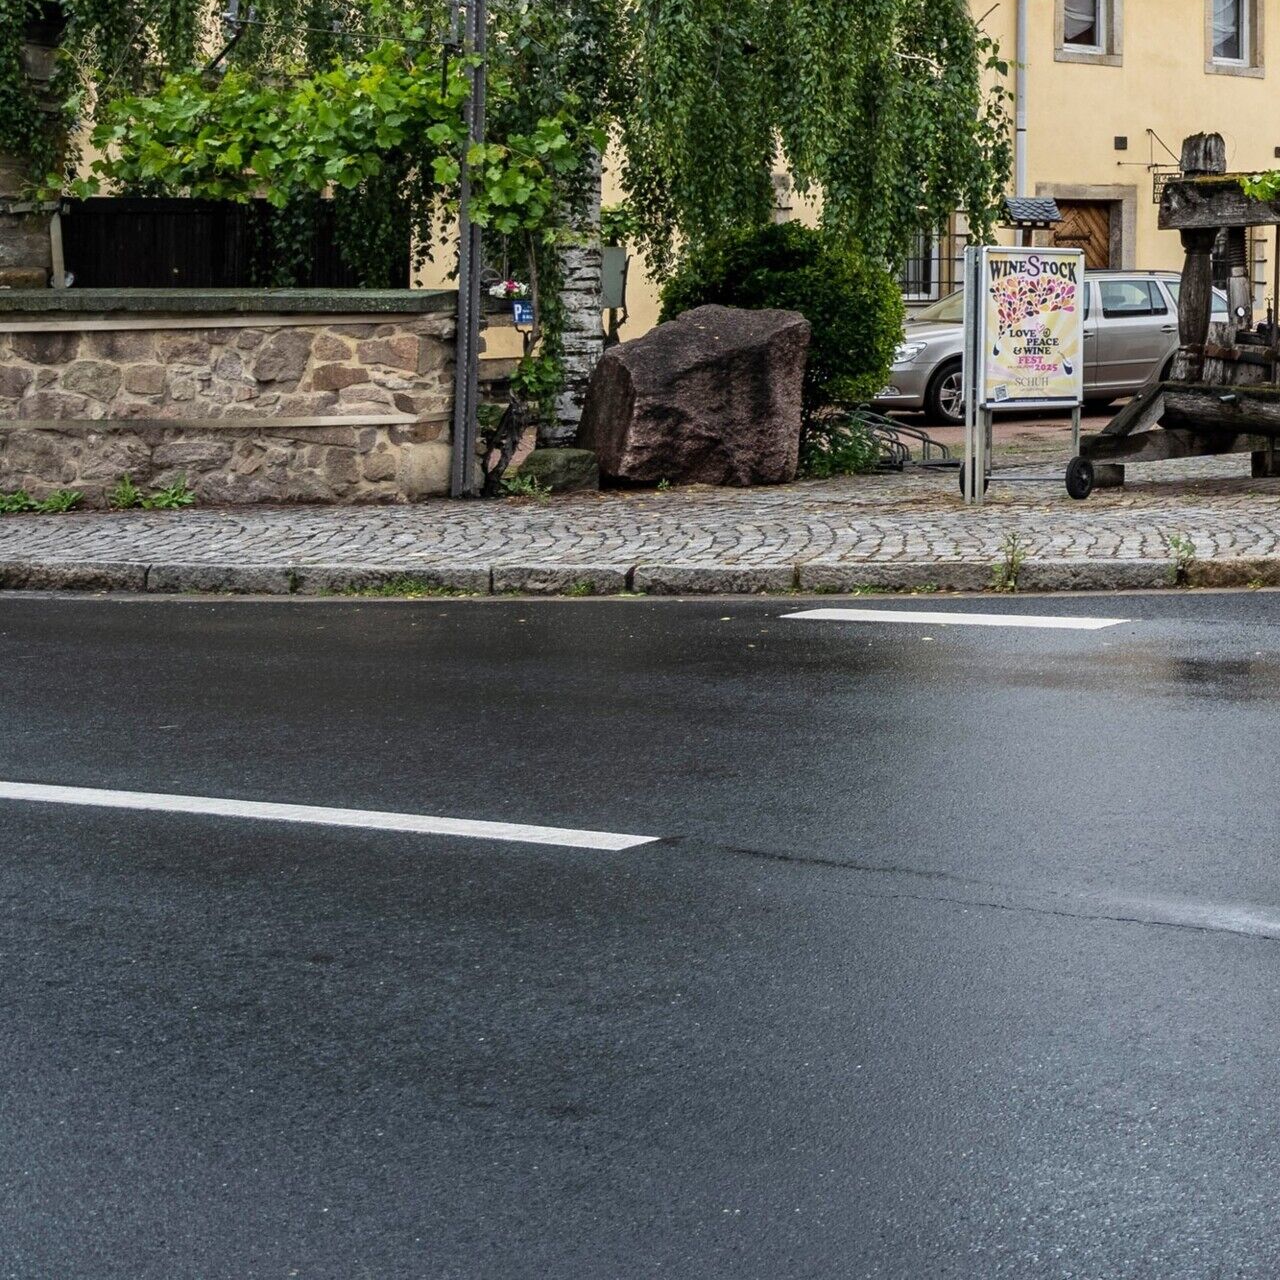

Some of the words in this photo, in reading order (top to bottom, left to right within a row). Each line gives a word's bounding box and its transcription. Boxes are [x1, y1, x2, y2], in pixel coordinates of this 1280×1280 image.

[989, 255, 1078, 285] WINESTOCK
[513, 303, 522, 321] P
[1009, 329, 1037, 337] LOVE
[1026, 338, 1059, 346] PEACE
[1013, 347, 1021, 355] &
[1023, 346, 1051, 355] WINE
[1018, 356, 1044, 364] FEST
[1034, 364, 1058, 372] 2025
[1015, 377, 1049, 387] SCHUH
